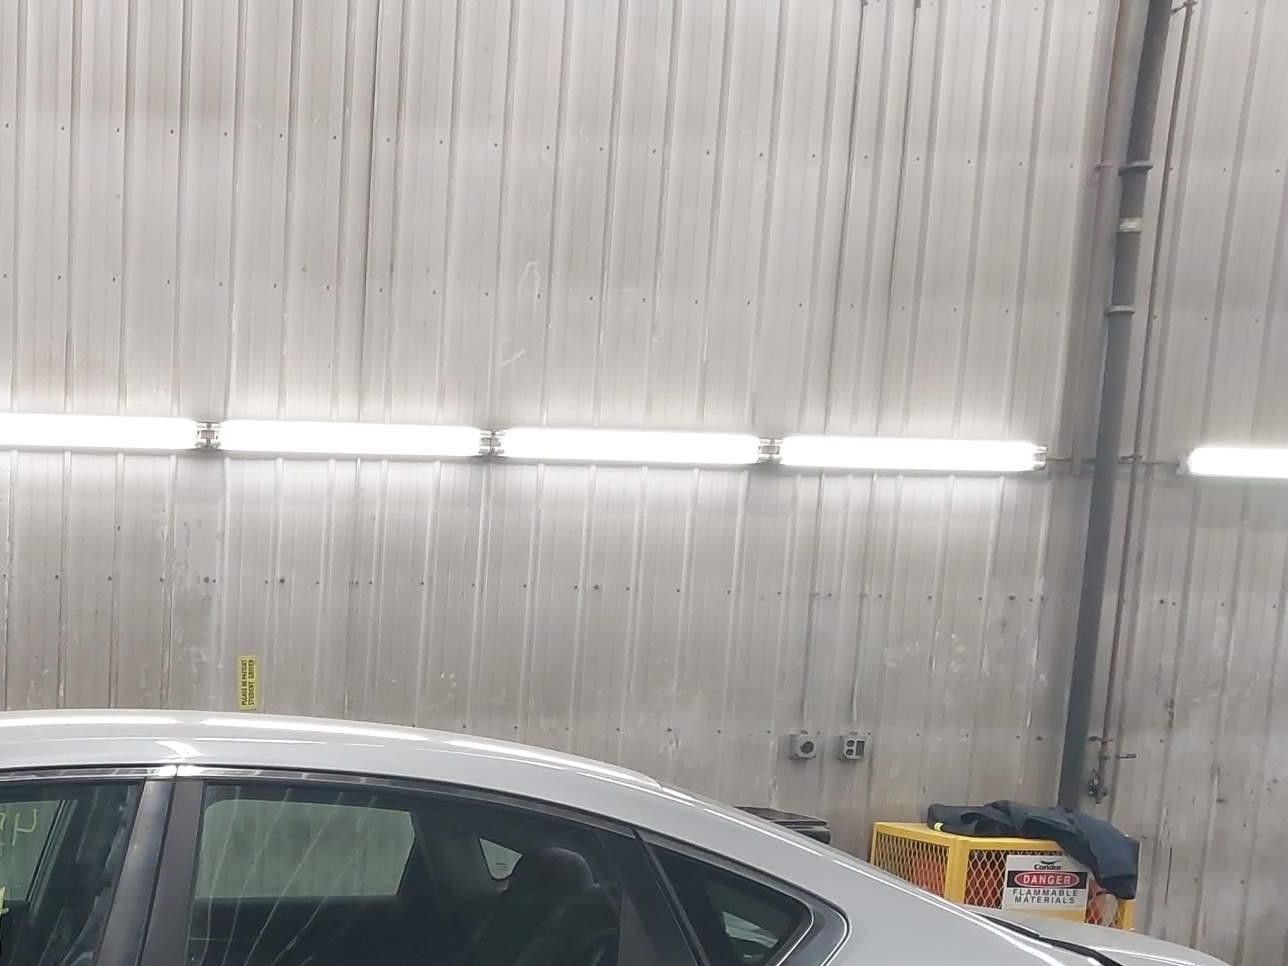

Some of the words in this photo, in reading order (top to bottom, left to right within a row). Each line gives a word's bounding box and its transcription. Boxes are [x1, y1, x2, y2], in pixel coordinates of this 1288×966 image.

[1023, 874, 1072, 885] DANGER
[1012, 888, 1079, 897] FLAMMABLE
[1014, 896, 1076, 904] MATERIALS
